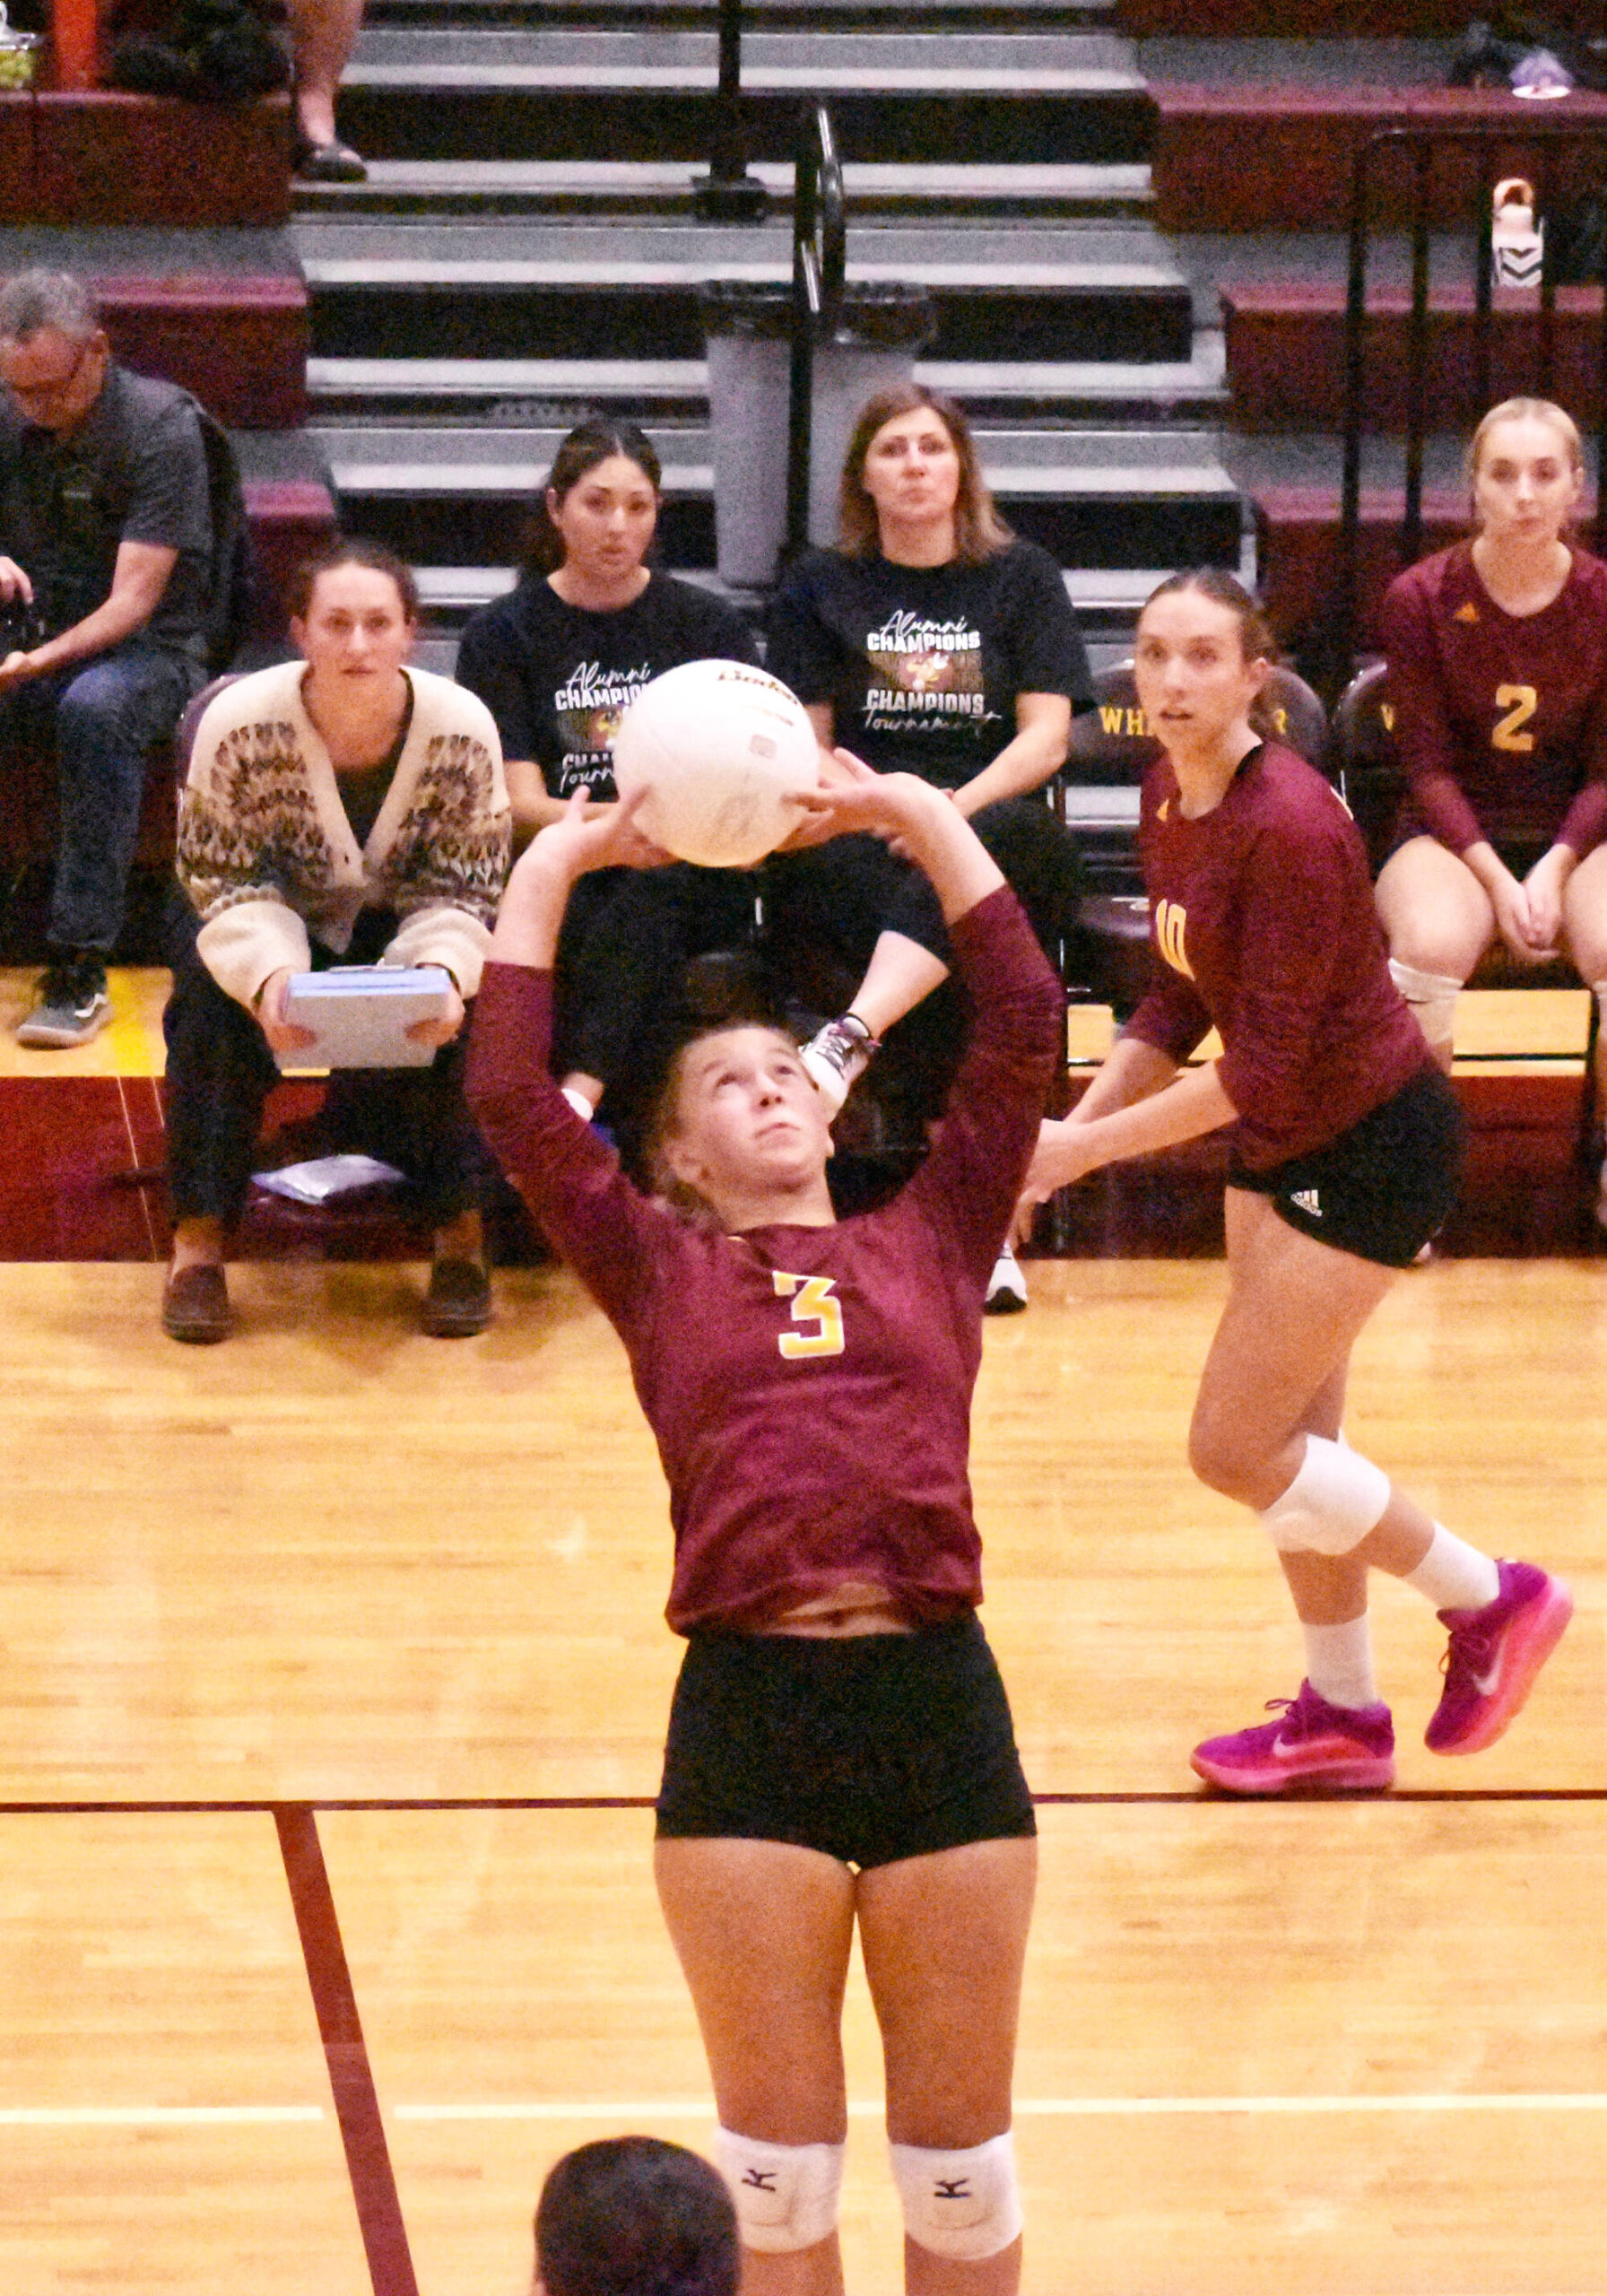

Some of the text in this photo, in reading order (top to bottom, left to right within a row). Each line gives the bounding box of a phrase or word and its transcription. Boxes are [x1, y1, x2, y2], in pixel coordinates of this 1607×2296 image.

[880, 609, 969, 638] Alumni
[866, 630, 981, 653] CHAMPIONS
[566, 661, 651, 690] Alumni
[554, 683, 648, 710] CHAMPIO
[866, 689, 985, 715] CHAMPIONS
[862, 706, 1003, 737] Tournat
[1492, 684, 1537, 751] 2
[1156, 899, 1196, 982] 10
[772, 1270, 845, 1360] 3
